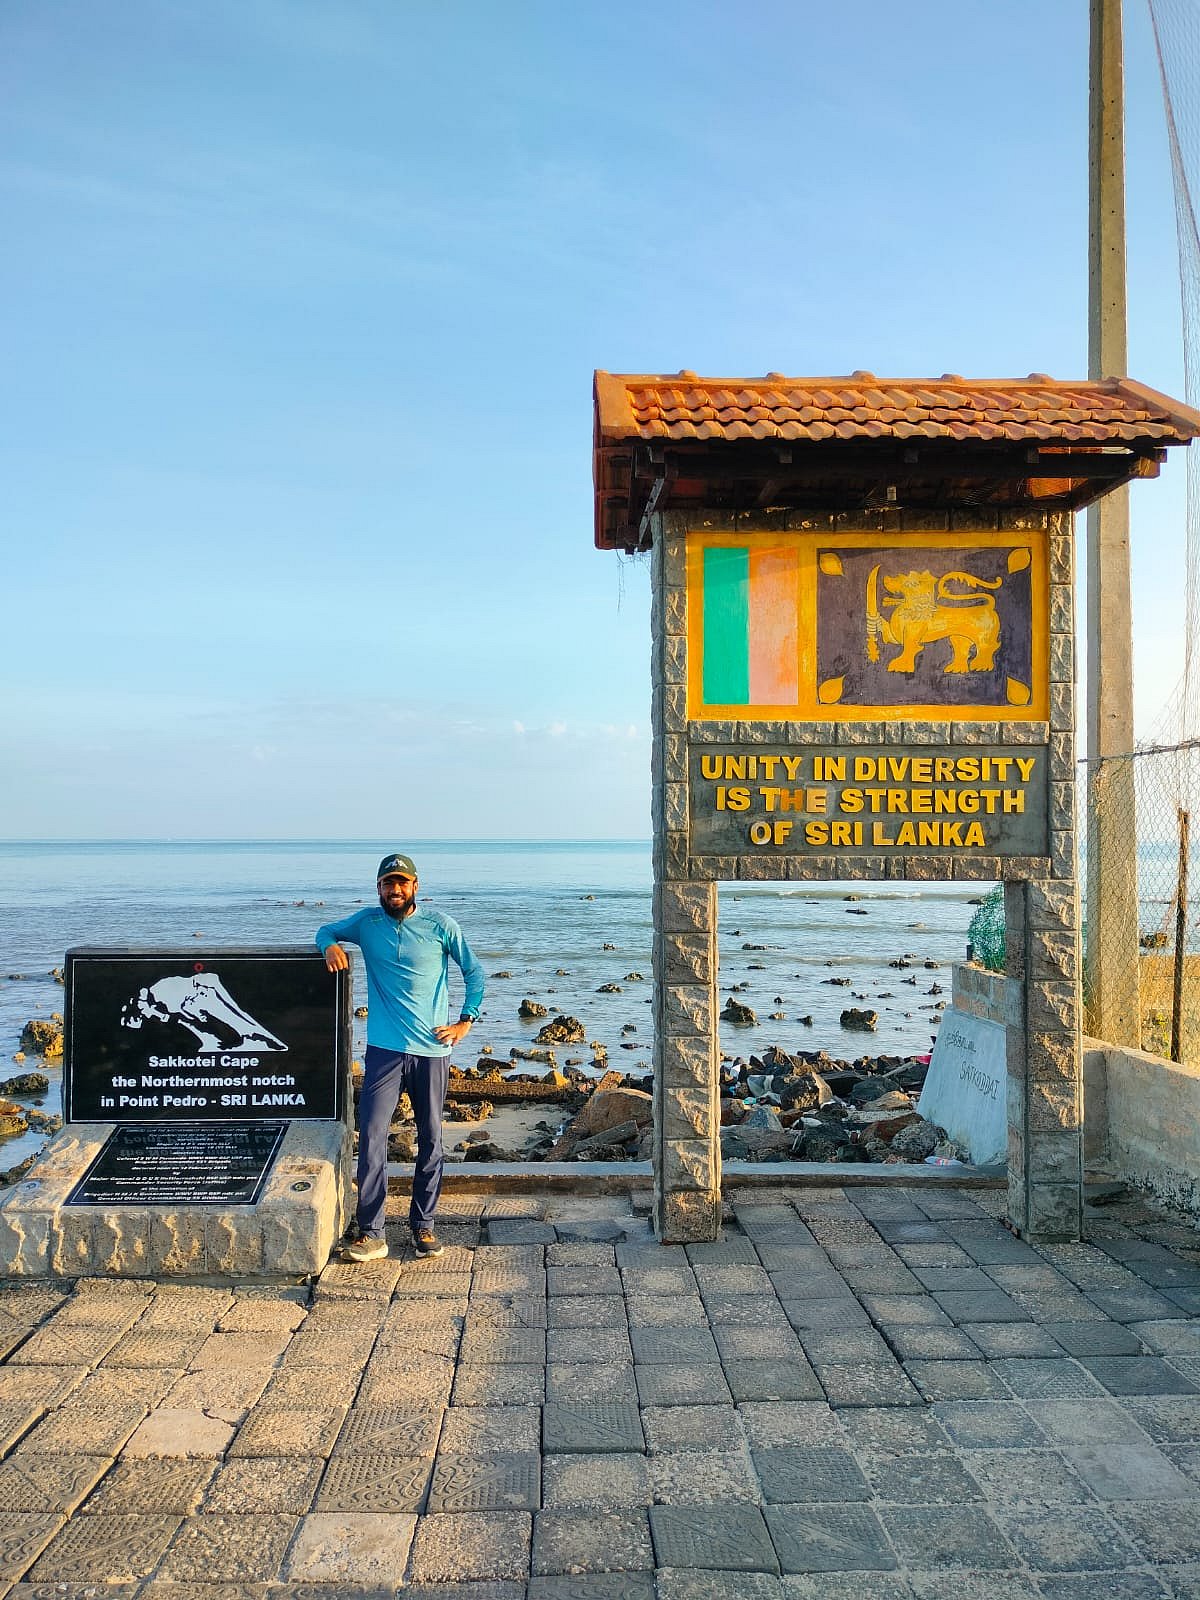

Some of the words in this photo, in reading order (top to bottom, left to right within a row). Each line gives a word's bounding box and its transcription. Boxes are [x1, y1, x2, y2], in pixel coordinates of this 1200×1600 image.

[701, 755, 801, 780] UNITY
[814, 756, 846, 781] IN
[854, 756, 1036, 782] DIVERSITY
[716, 787, 751, 811] IS
[759, 788, 828, 813] THE
[839, 789, 1025, 814] STRENGTH
[750, 820, 791, 846] OF
[805, 821, 862, 846] SRI
[872, 822, 986, 847] LANKA
[148, 1056, 216, 1067] Sakkotei
[220, 1055, 259, 1069] Cape
[112, 1076, 137, 1087] the
[141, 1075, 248, 1087] Northernmost
[252, 1074, 295, 1086] notch
[101, 1096, 115, 1107] in
[119, 1095, 159, 1107] Point
[163, 1095, 207, 1107] Pedro
[220, 1095, 247, 1106] SRI
[251, 1094, 306, 1106] LANKA
